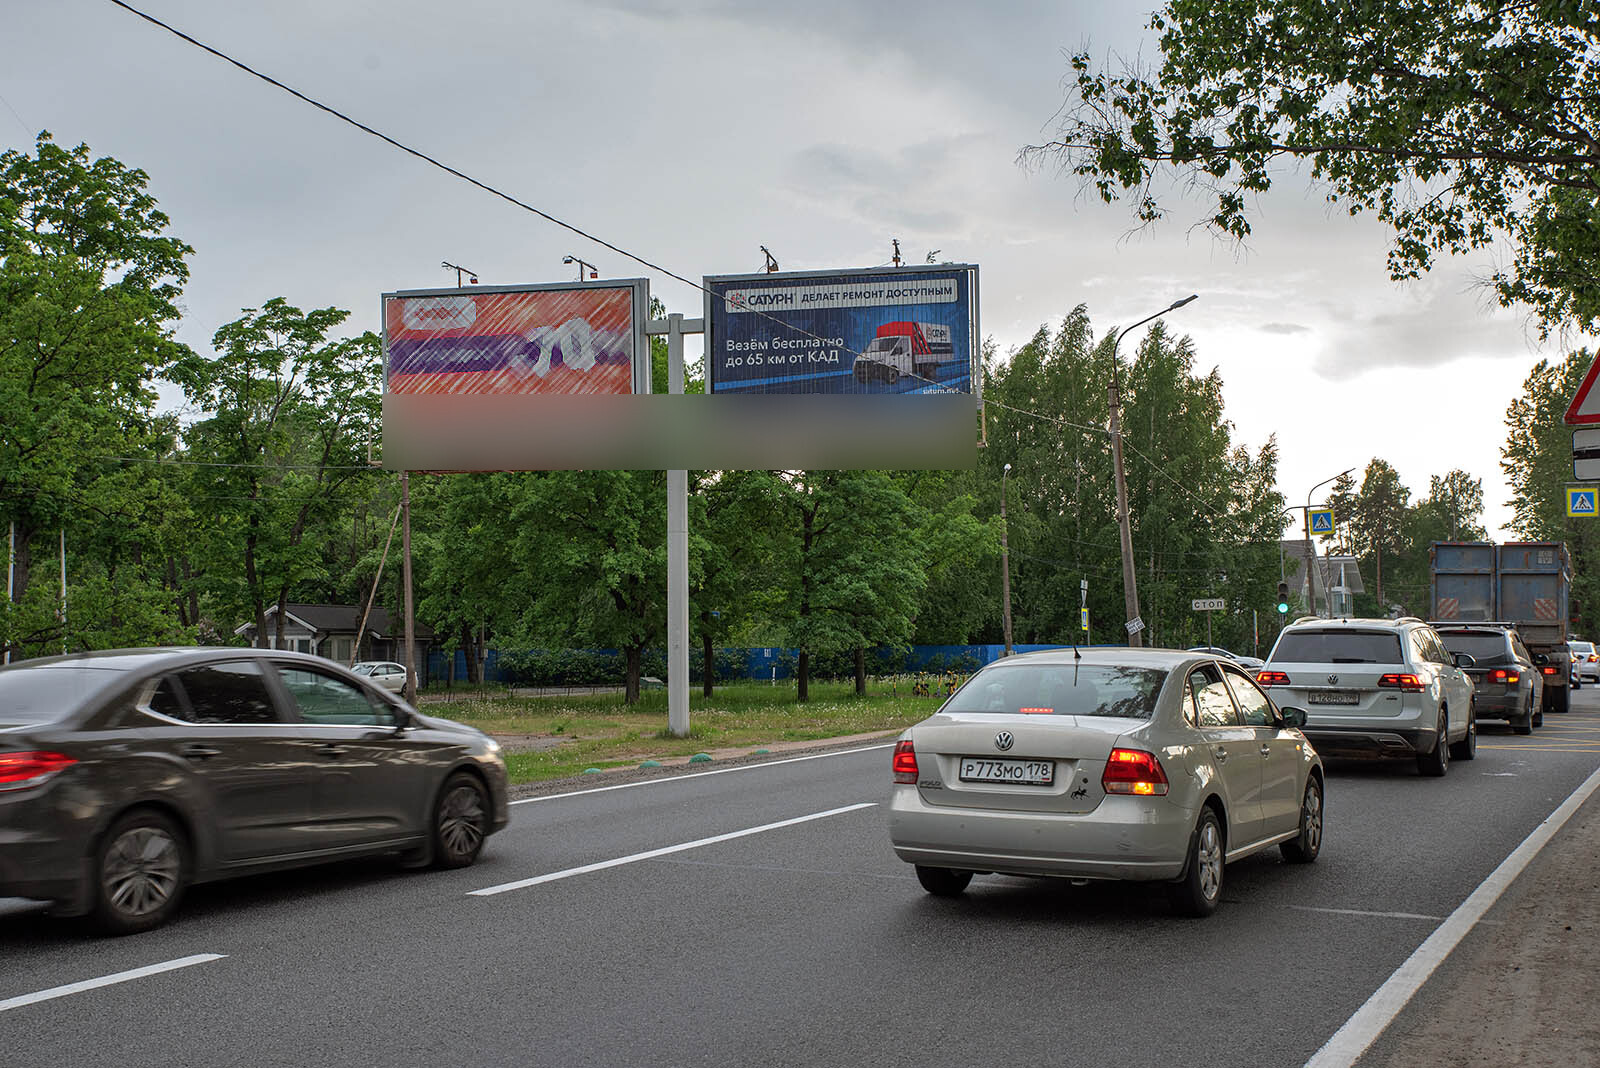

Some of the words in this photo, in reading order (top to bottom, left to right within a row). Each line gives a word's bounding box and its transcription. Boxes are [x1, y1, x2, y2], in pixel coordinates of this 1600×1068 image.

[748, 293, 793, 305] САТУРН
[801, 292, 840, 303] ДЕЛАЕТ
[843, 290, 884, 300] РЕМОНТ
[886, 287, 952, 299] ДОСТУПНЫМ
[726, 338, 768, 351] Везём
[772, 336, 843, 350] бесплатно
[725, 357, 743, 368] до
[746, 353, 763, 366] 65
[767, 355, 785, 364] км
[789, 354, 804, 363] от
[808, 350, 839, 364] КАД
